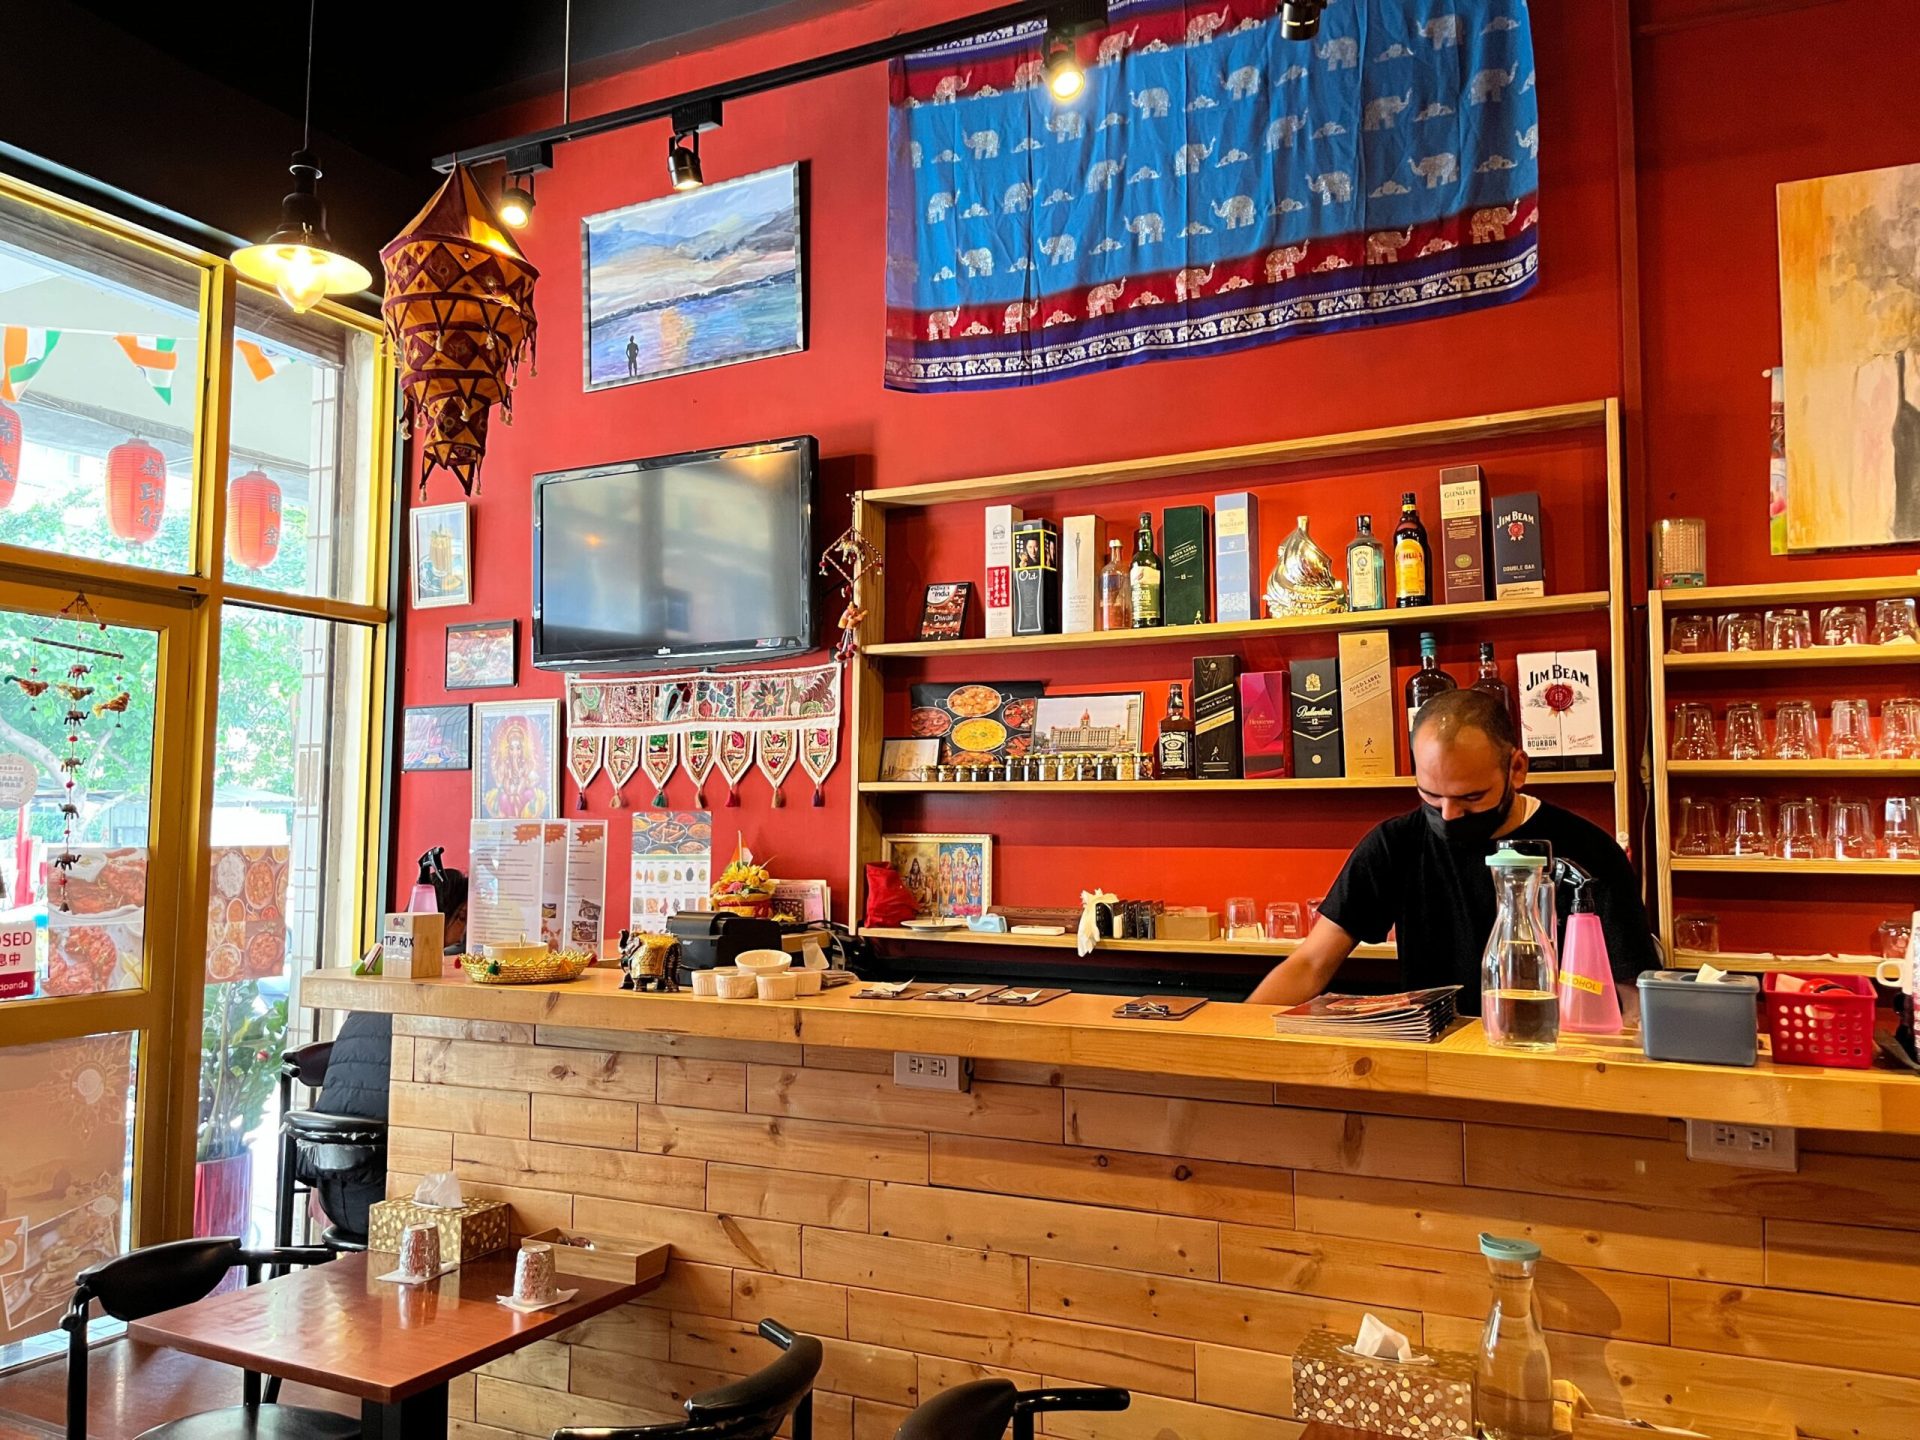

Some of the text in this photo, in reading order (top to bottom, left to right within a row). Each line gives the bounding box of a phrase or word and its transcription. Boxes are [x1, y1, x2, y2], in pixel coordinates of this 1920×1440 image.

[1457, 498, 1465, 506] 15
[1497, 510, 1535, 529] JIM BEAM
[1502, 564, 1523, 572] DOUBLE
[933, 614, 954, 622] Diwali
[1526, 663, 1590, 692] JIM BEAM
[1196, 695, 1232, 713] DOUBLE BLACK
[1527, 739, 1558, 748] BOURBON
[0, 931, 33, 947] SED
[384, 935, 414, 948] TIP BOX
